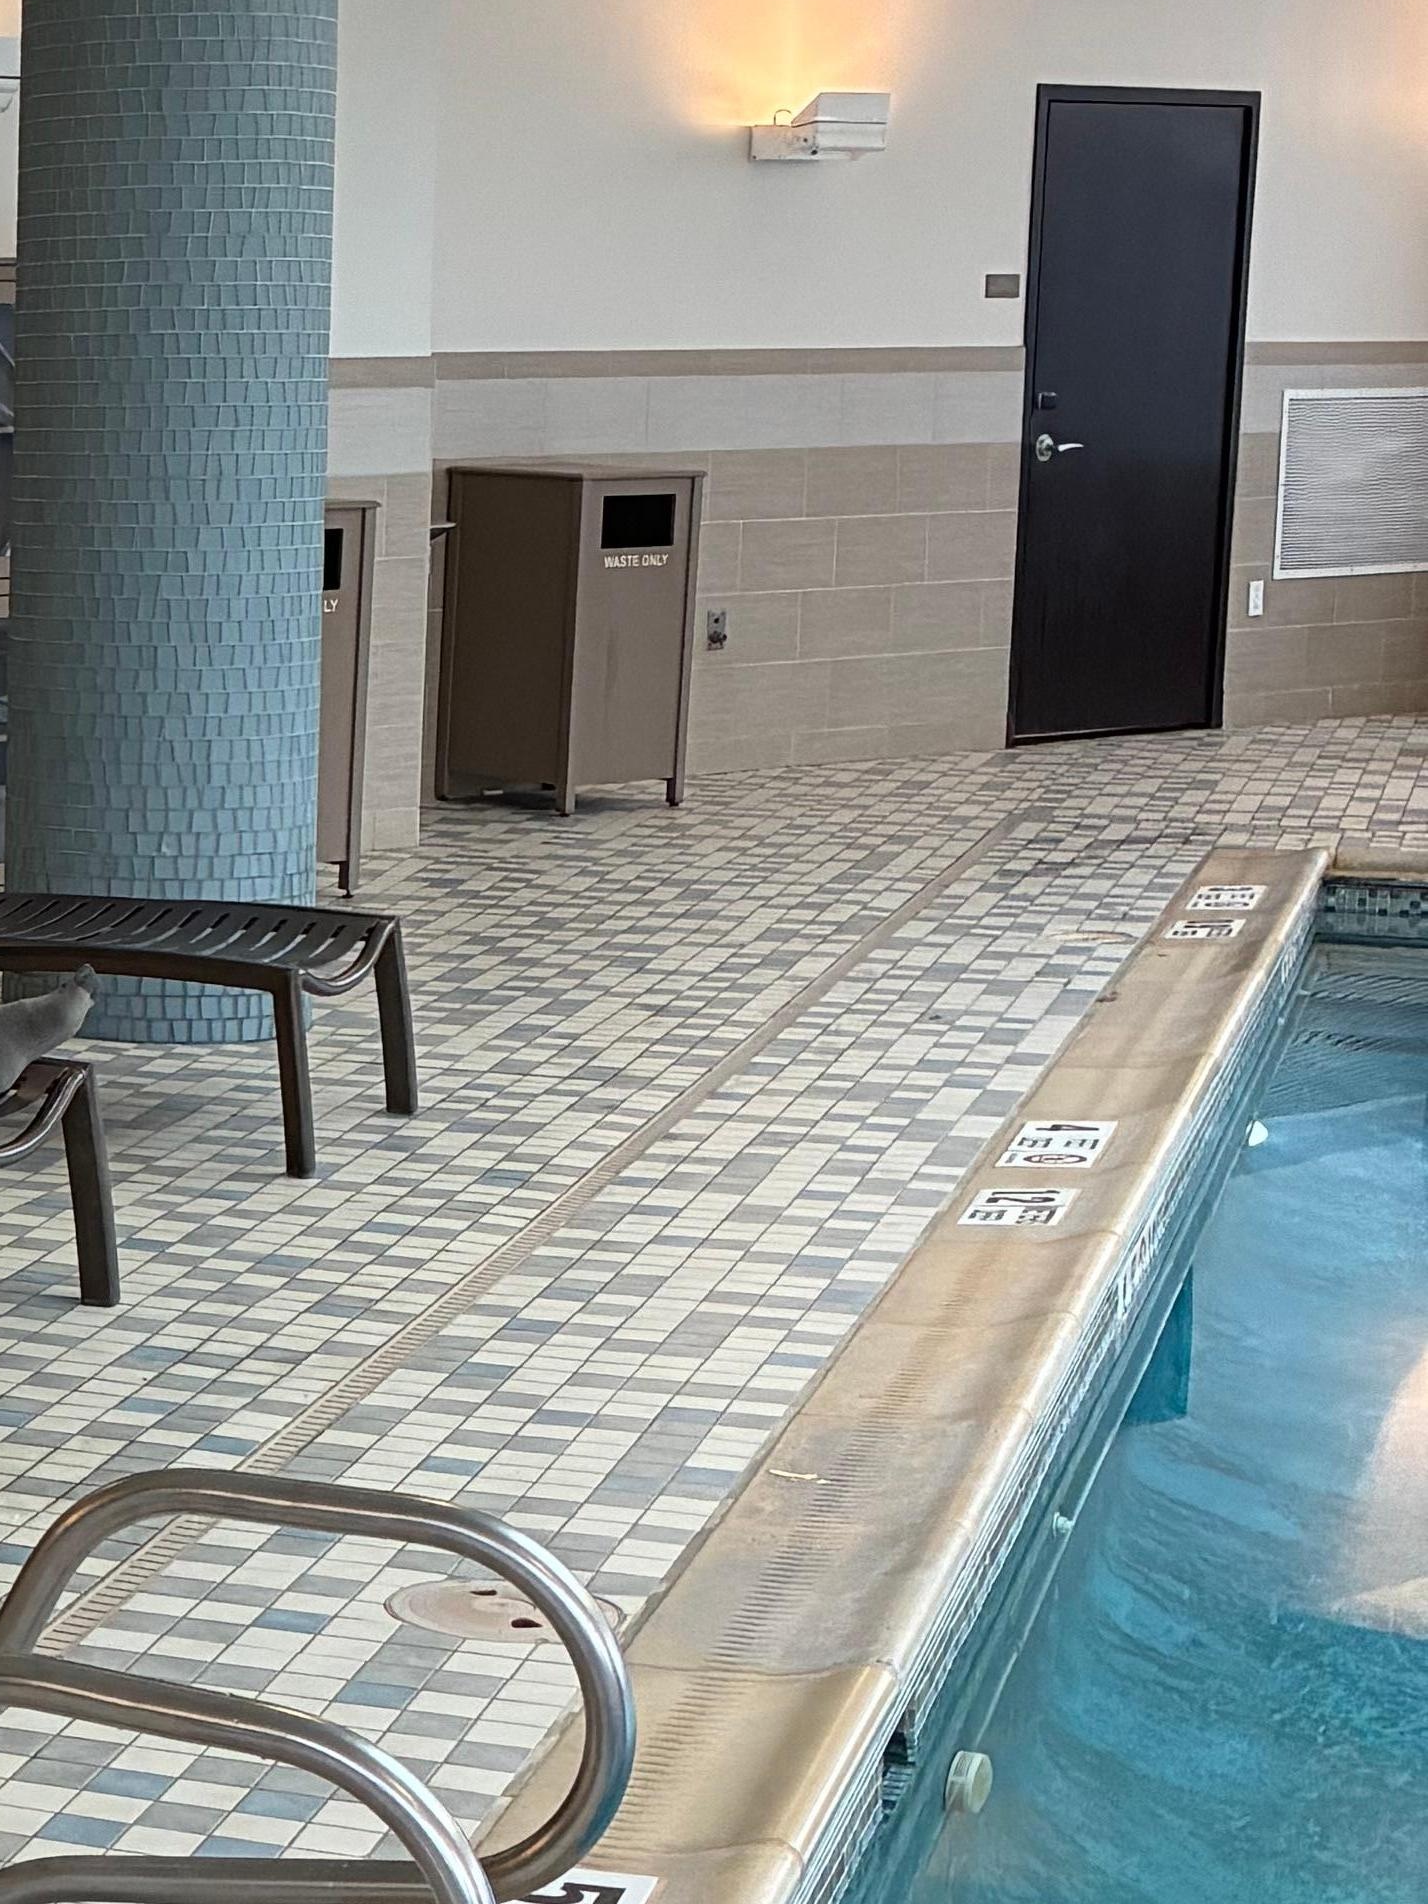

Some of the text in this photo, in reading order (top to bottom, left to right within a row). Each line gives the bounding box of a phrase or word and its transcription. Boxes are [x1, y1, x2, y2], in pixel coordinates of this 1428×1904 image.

[604, 553, 669, 568] WASTE ONLY
[324, 598, 339, 612] LY
